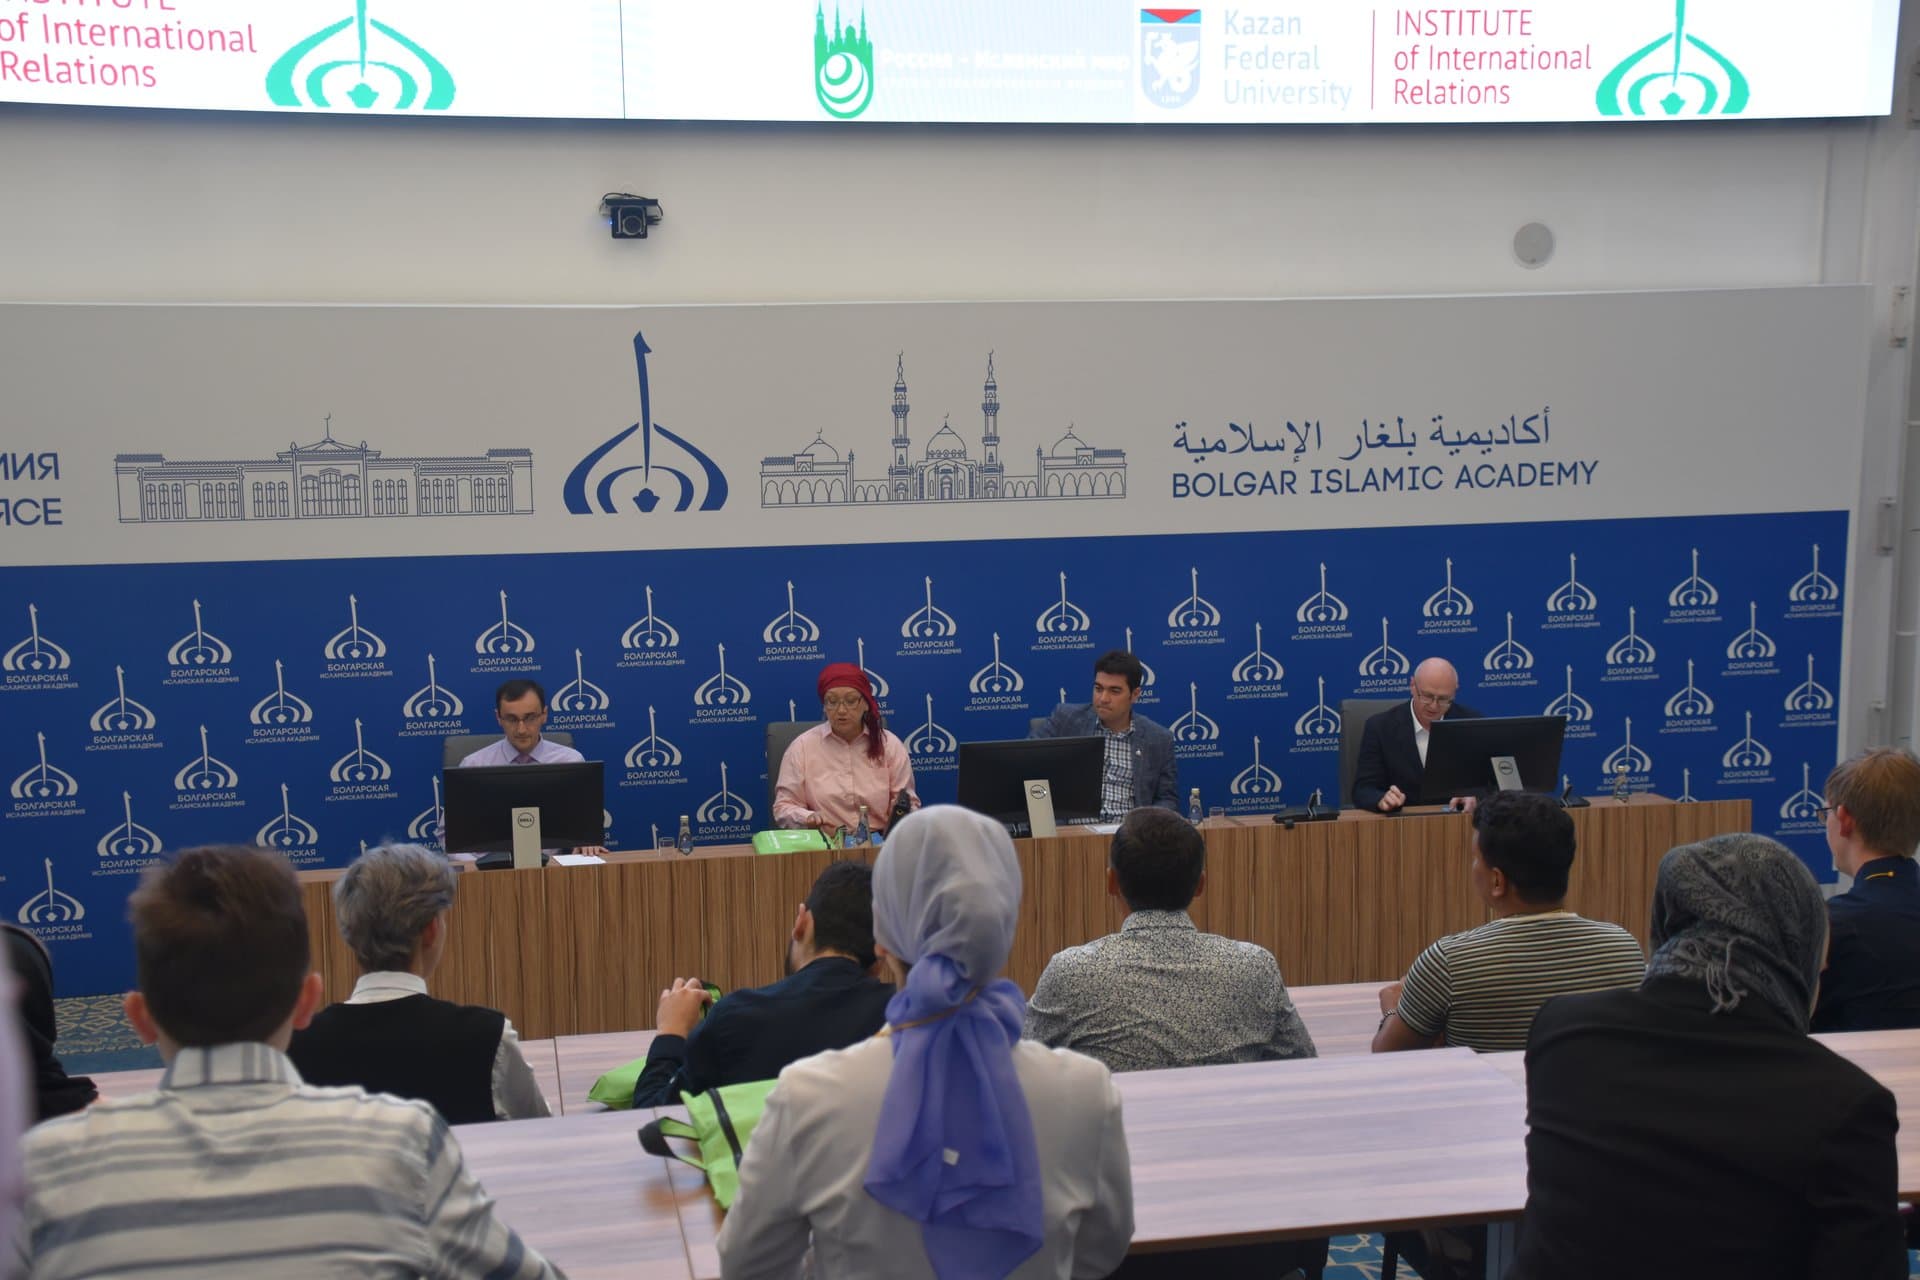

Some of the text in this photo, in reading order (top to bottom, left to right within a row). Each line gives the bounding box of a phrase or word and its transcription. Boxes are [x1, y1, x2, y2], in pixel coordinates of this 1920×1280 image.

[1225, 10, 1300, 35] Kazan
[1397, 10, 1532, 36] INSTITUTE
[0, 12, 256, 54] of International
[1225, 44, 1319, 69] Federal
[1395, 45, 1591, 70] of International
[0, 51, 156, 87] Relations
[1225, 80, 1351, 110] University
[1395, 78, 1509, 104] Relations
[1339, 416, 1416, 461] بلغار
[1173, 460, 1599, 498] BOLGAR ISLAMIC ACADEMY
[1424, 619, 1471, 628] БОЛГАРСКАЯ
[1298, 624, 1346, 633] БОЛГАРСКАЯ
[1170, 630, 1218, 639] БОЛГАРСКАЯ
[1038, 635, 1087, 644] БОЛГАРСКАЯ
[904, 640, 954, 649] БОЛГАРСКАЯ
[766, 645, 817, 655] БОЛГАРСКАЯ
[624, 651, 677, 660] БОЛГАРСКАЯ
[478, 657, 533, 666] БОЛГАРСКАЯ
[328, 662, 384, 671] БОЛГАРСКАЯ
[171, 668, 230, 677] БОЛГАРСКАЯ
[1485, 672, 1531, 681] БОЛГАРСКАЯ
[6, 674, 68, 683] БОЛГАРСКАЯ
[1234, 684, 1281, 693] БОЛГАРСКАЯ
[971, 696, 1021, 704] БОЛГАРСКАЯ
[697, 708, 749, 717] БОЛГАРСКАЯ
[553, 714, 607, 723] БОЛГАРСКАЯ
[406, 720, 461, 730] БОЛГАРСКАЯ
[253, 727, 311, 736] БОЛГАРСКАЯ
[94, 734, 154, 743] БОЛГАРСКАЯ
[1296, 738, 1339, 746] БОЛГАРСКА
[1175, 744, 1217, 752] ОЛГАРСКАЯ
[910, 756, 955, 765] ОЛГАРСКАЯ
[627, 770, 680, 779] БОЛГАРСКАЯ
[333, 784, 389, 794] БОЛГАРСКАЯ
[178, 792, 236, 802] БОЛГАРСКАЯ
[14, 800, 76, 811] БОЛГАРСКАЯ
[699, 825, 750, 834] БОЛГАРСКАЯ
[30, 925, 83, 935] ОЛГАРСКАЯ
